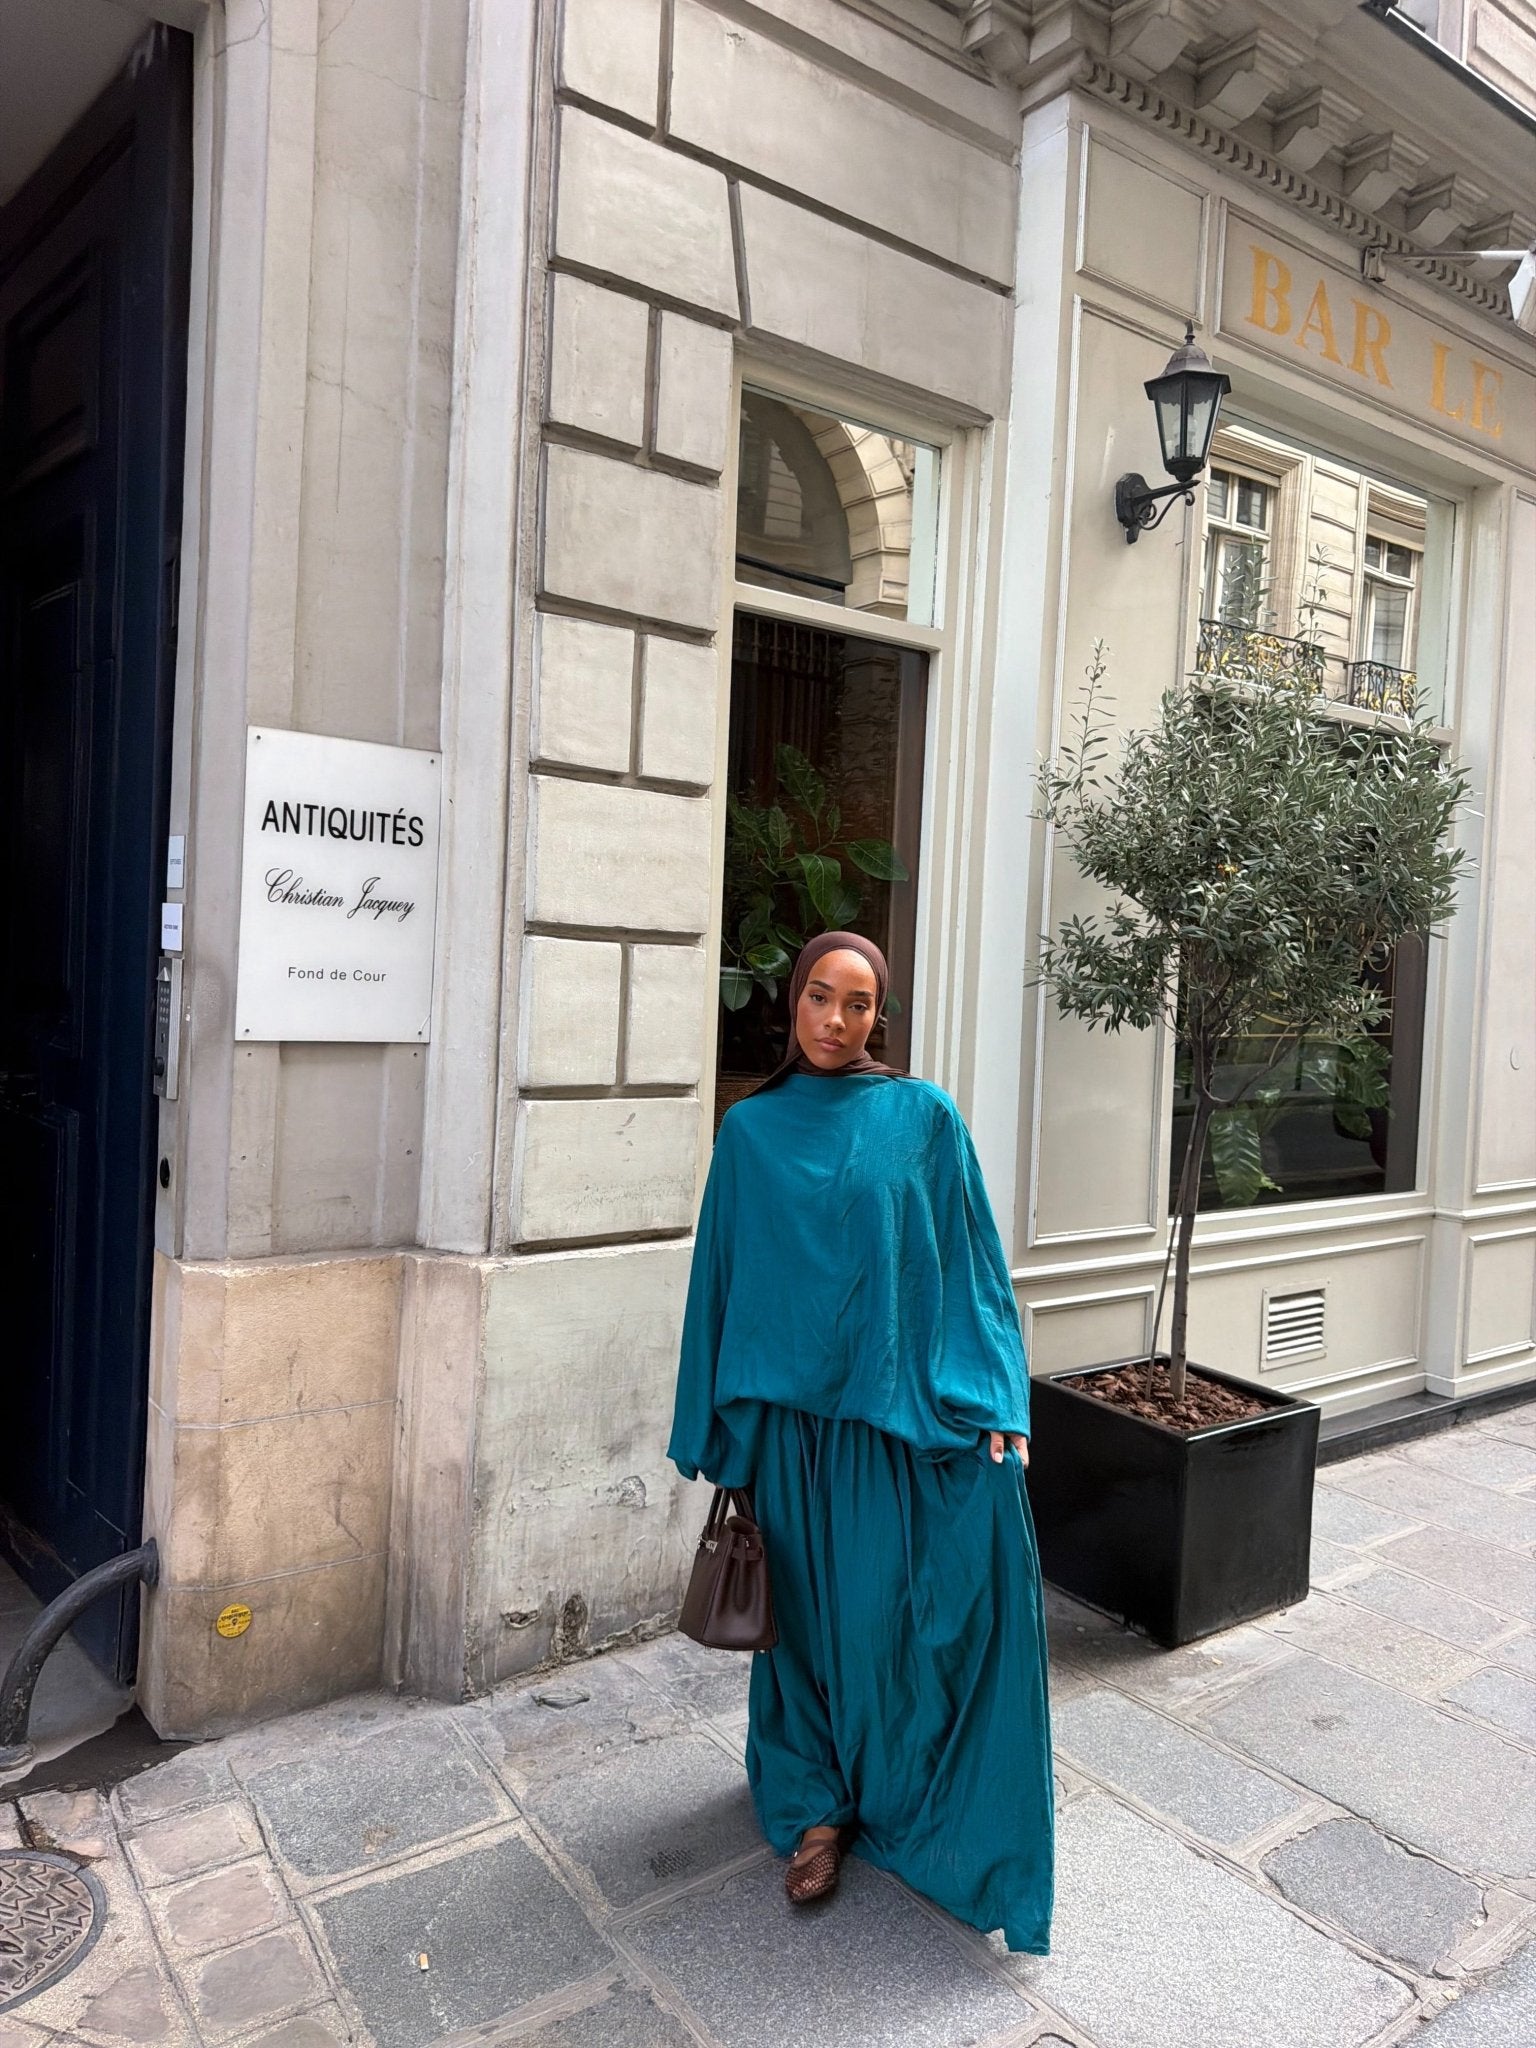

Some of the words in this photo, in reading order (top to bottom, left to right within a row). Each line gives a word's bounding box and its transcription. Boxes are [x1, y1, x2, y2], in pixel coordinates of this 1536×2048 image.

[1243, 244, 1394, 389] BAR
[1429, 337, 1504, 439] LE
[261, 800, 424, 846] ANTIQUITÉS
[264, 867, 345, 905] Christian
[347, 876, 416, 923] Jacquey
[288, 966, 324, 981] Fond
[330, 968, 347, 981] de
[352, 969, 387, 982] Cour
[12, 1962, 46, 1990] C250
